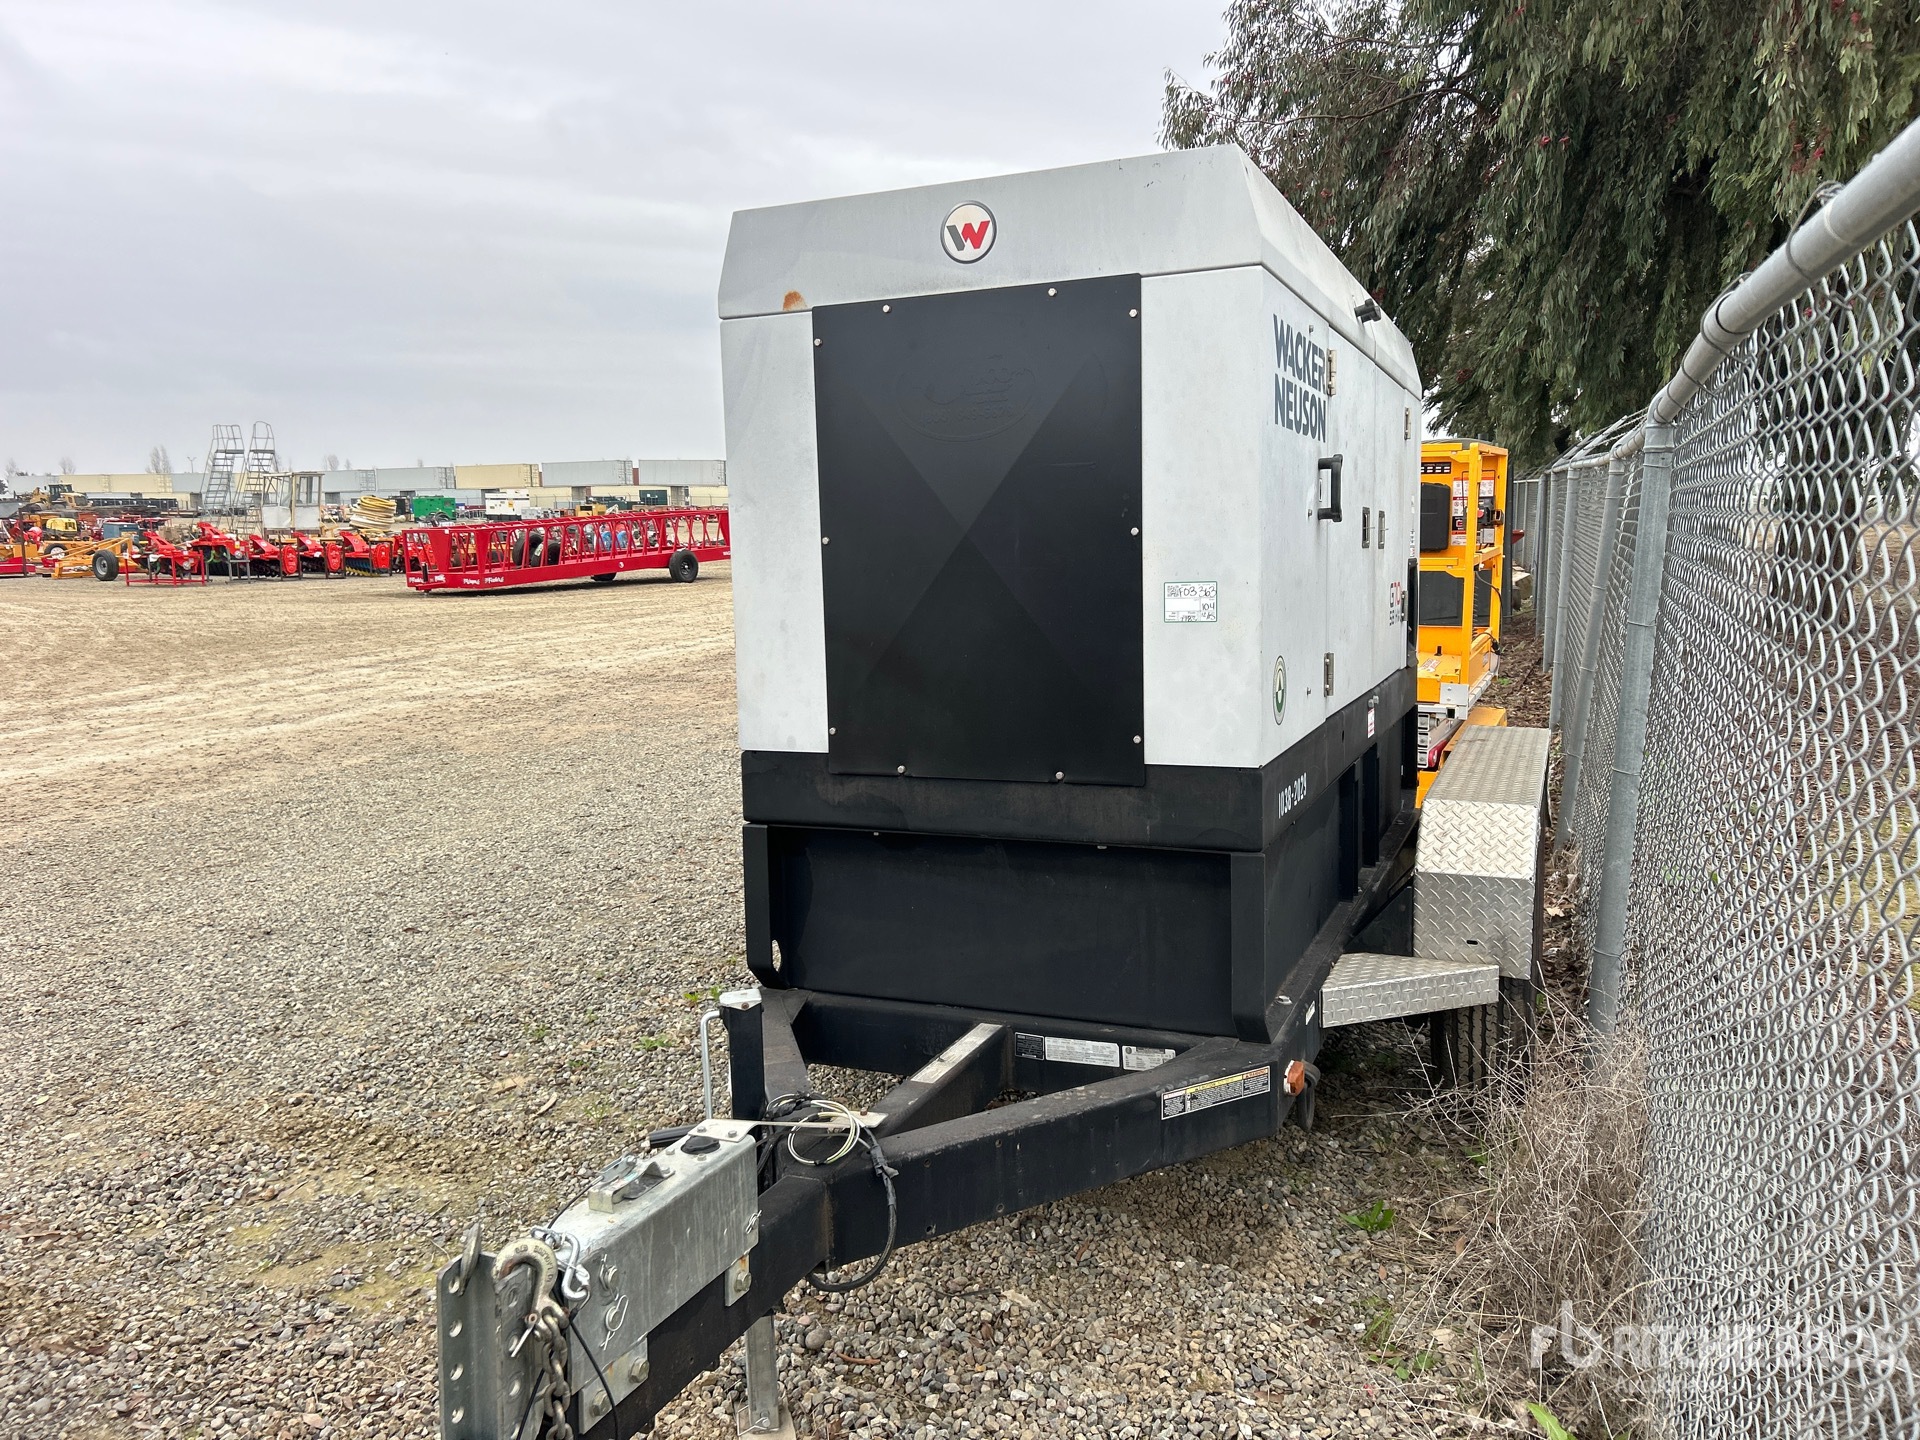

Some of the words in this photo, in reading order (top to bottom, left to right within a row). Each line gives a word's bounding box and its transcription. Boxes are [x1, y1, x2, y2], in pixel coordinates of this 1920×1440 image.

[1273, 313, 1326, 394] WACKER
[1275, 373, 1326, 443] NEUSON
[1279, 772, 1307, 819] 1038-2029
